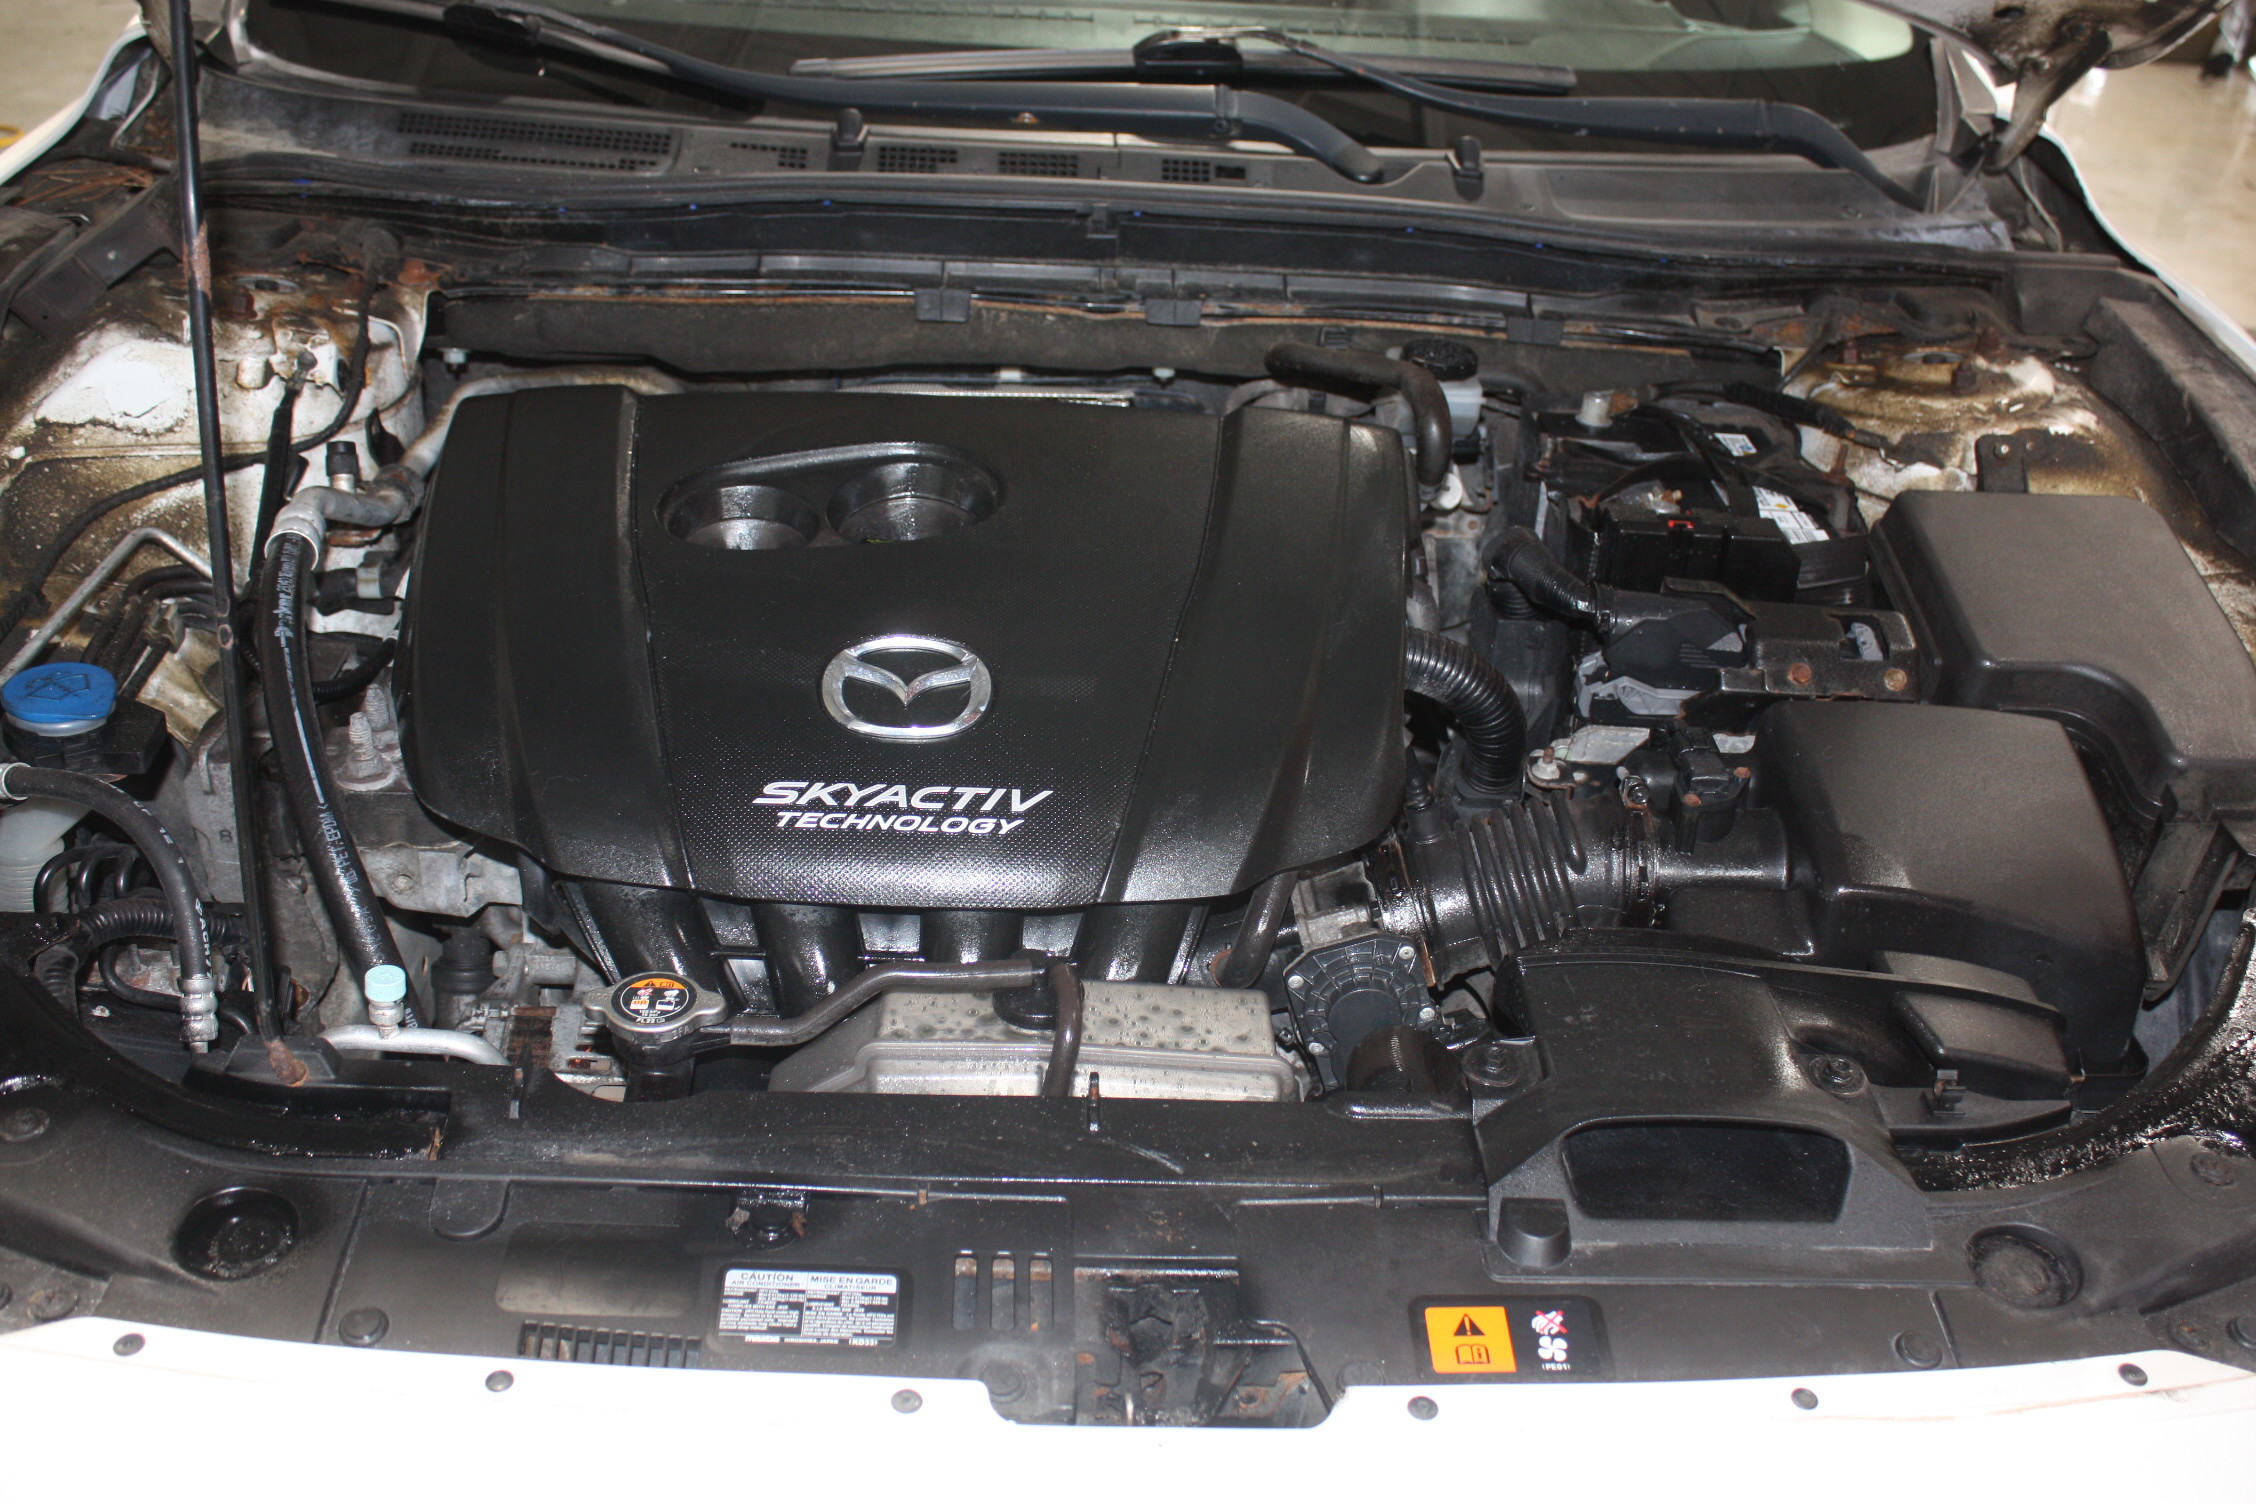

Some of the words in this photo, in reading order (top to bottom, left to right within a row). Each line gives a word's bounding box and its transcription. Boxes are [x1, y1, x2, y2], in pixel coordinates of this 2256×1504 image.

[752, 781, 1054, 812] SKYACTIV
[776, 811, 1025, 834] TECHNOLOGY
[741, 1272, 794, 1281] CAUTION
[811, 1276, 836, 1284] MISE
[839, 1276, 853, 1284] EN
[856, 1277, 893, 1285] GARDE
